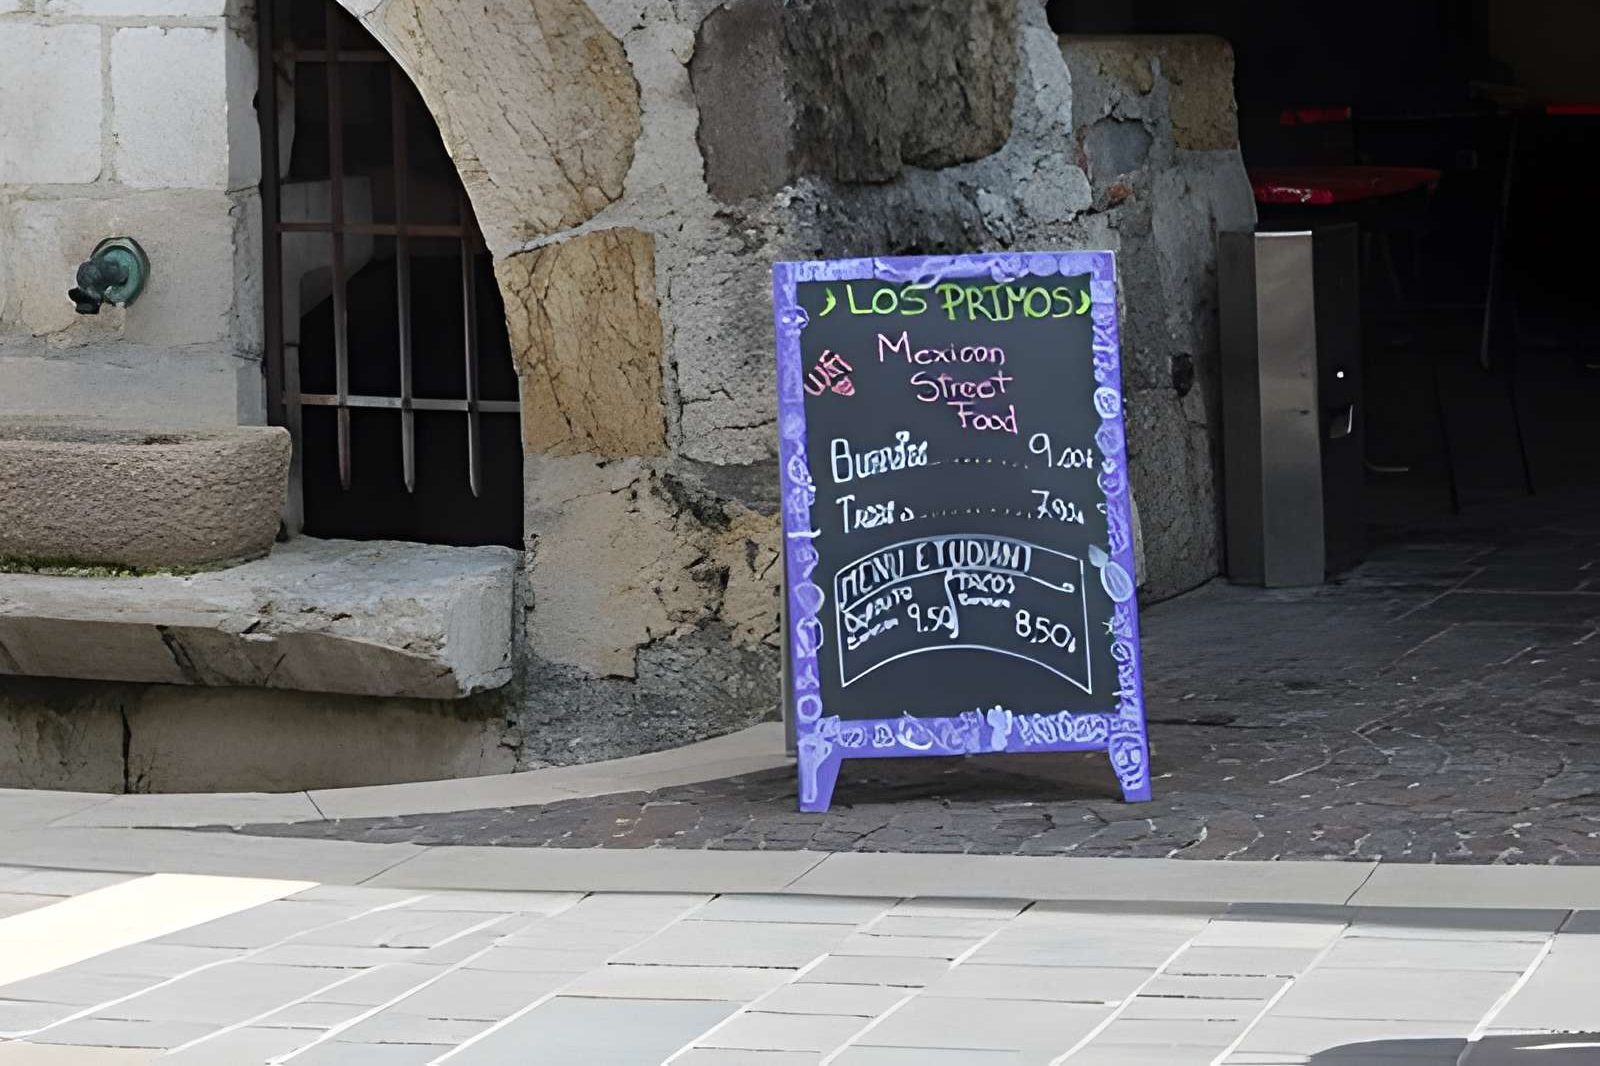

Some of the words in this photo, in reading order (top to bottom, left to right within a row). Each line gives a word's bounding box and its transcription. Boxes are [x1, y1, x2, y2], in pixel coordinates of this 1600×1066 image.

[846, 284, 929, 316] LOS
[935, 283, 1074, 321] PRIMOS
[910, 370, 1014, 402] Street
[946, 400, 1018, 434] Food
